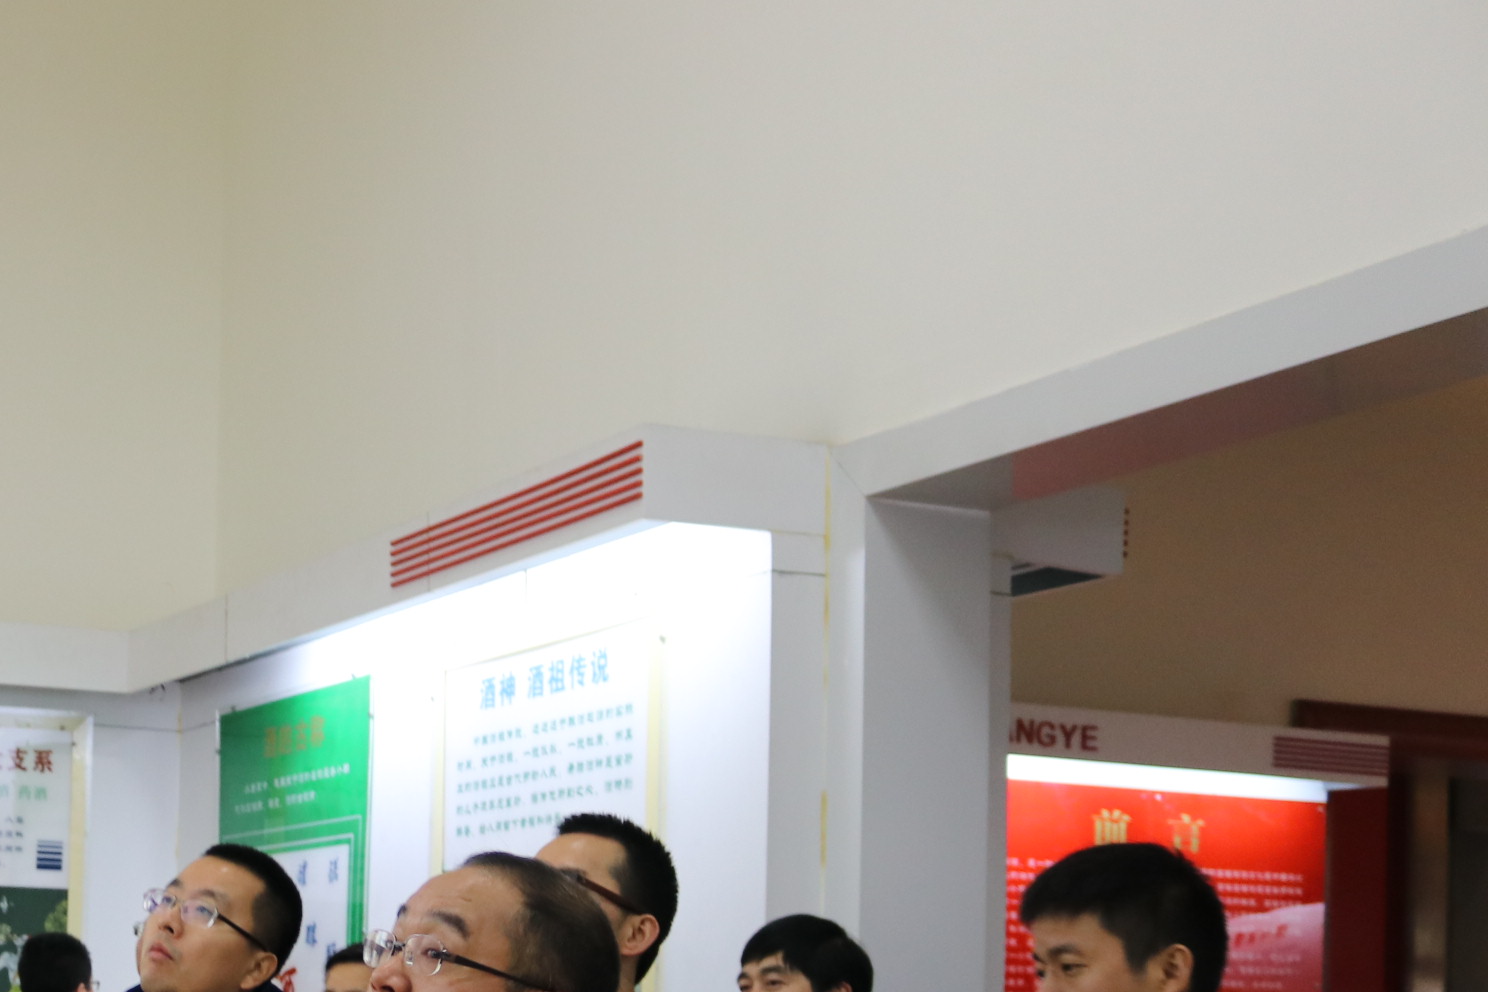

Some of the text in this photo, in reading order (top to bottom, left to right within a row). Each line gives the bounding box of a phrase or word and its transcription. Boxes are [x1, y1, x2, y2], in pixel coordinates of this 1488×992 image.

[479, 648, 609, 711] 酒神 酒祖传说
